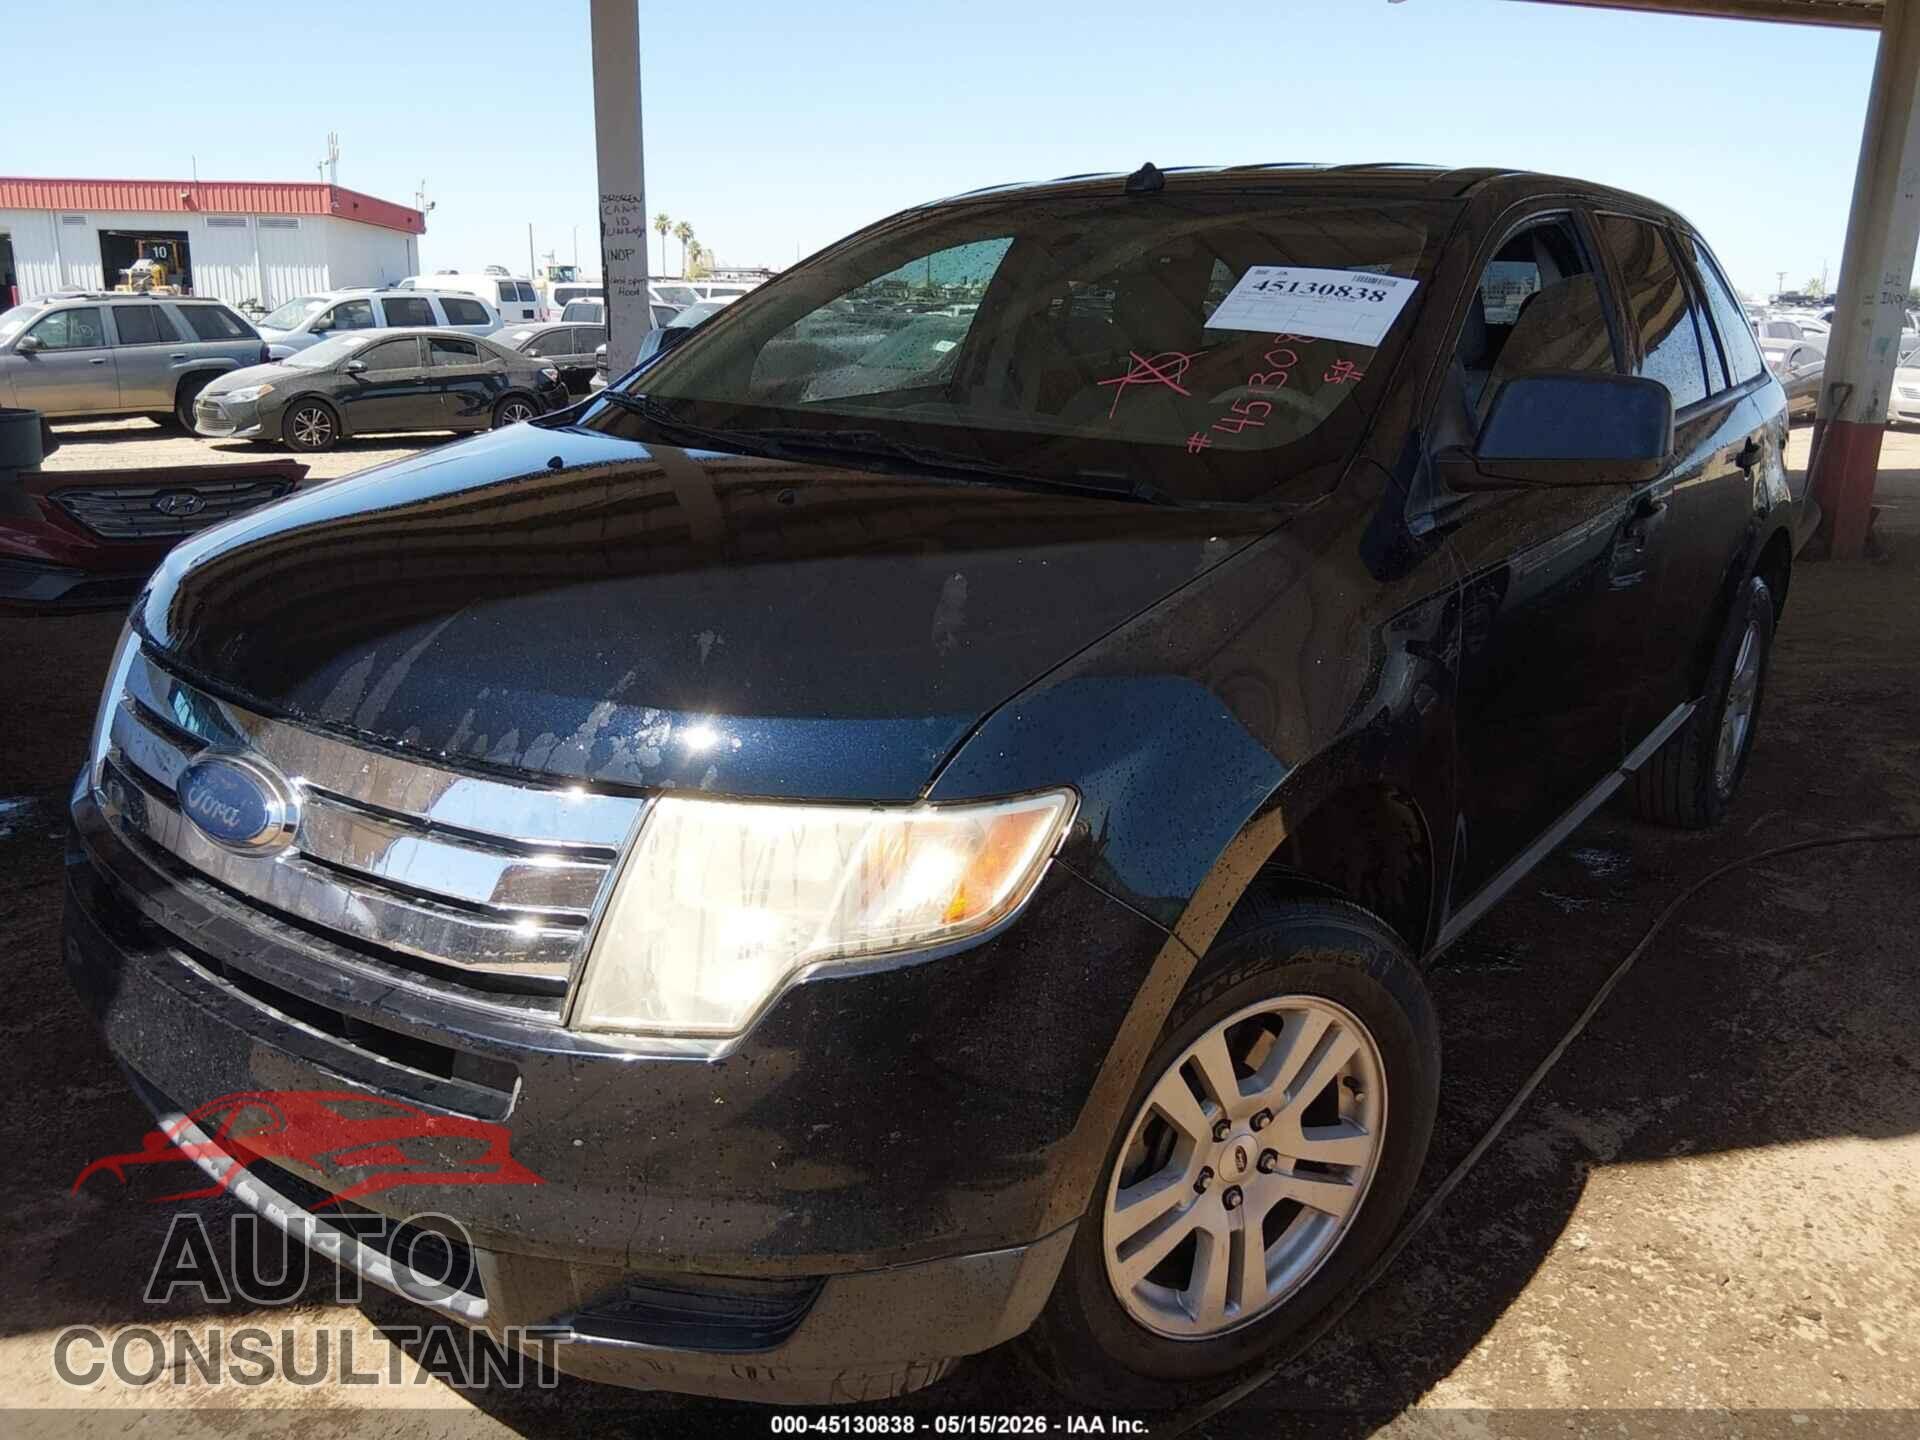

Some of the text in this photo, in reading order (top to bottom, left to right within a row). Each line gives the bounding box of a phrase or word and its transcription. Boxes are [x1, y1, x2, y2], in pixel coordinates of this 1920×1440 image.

[153, 246, 167, 258] 10
[1252, 280, 1388, 303] 45130838
[188, 780, 241, 828] Ford
